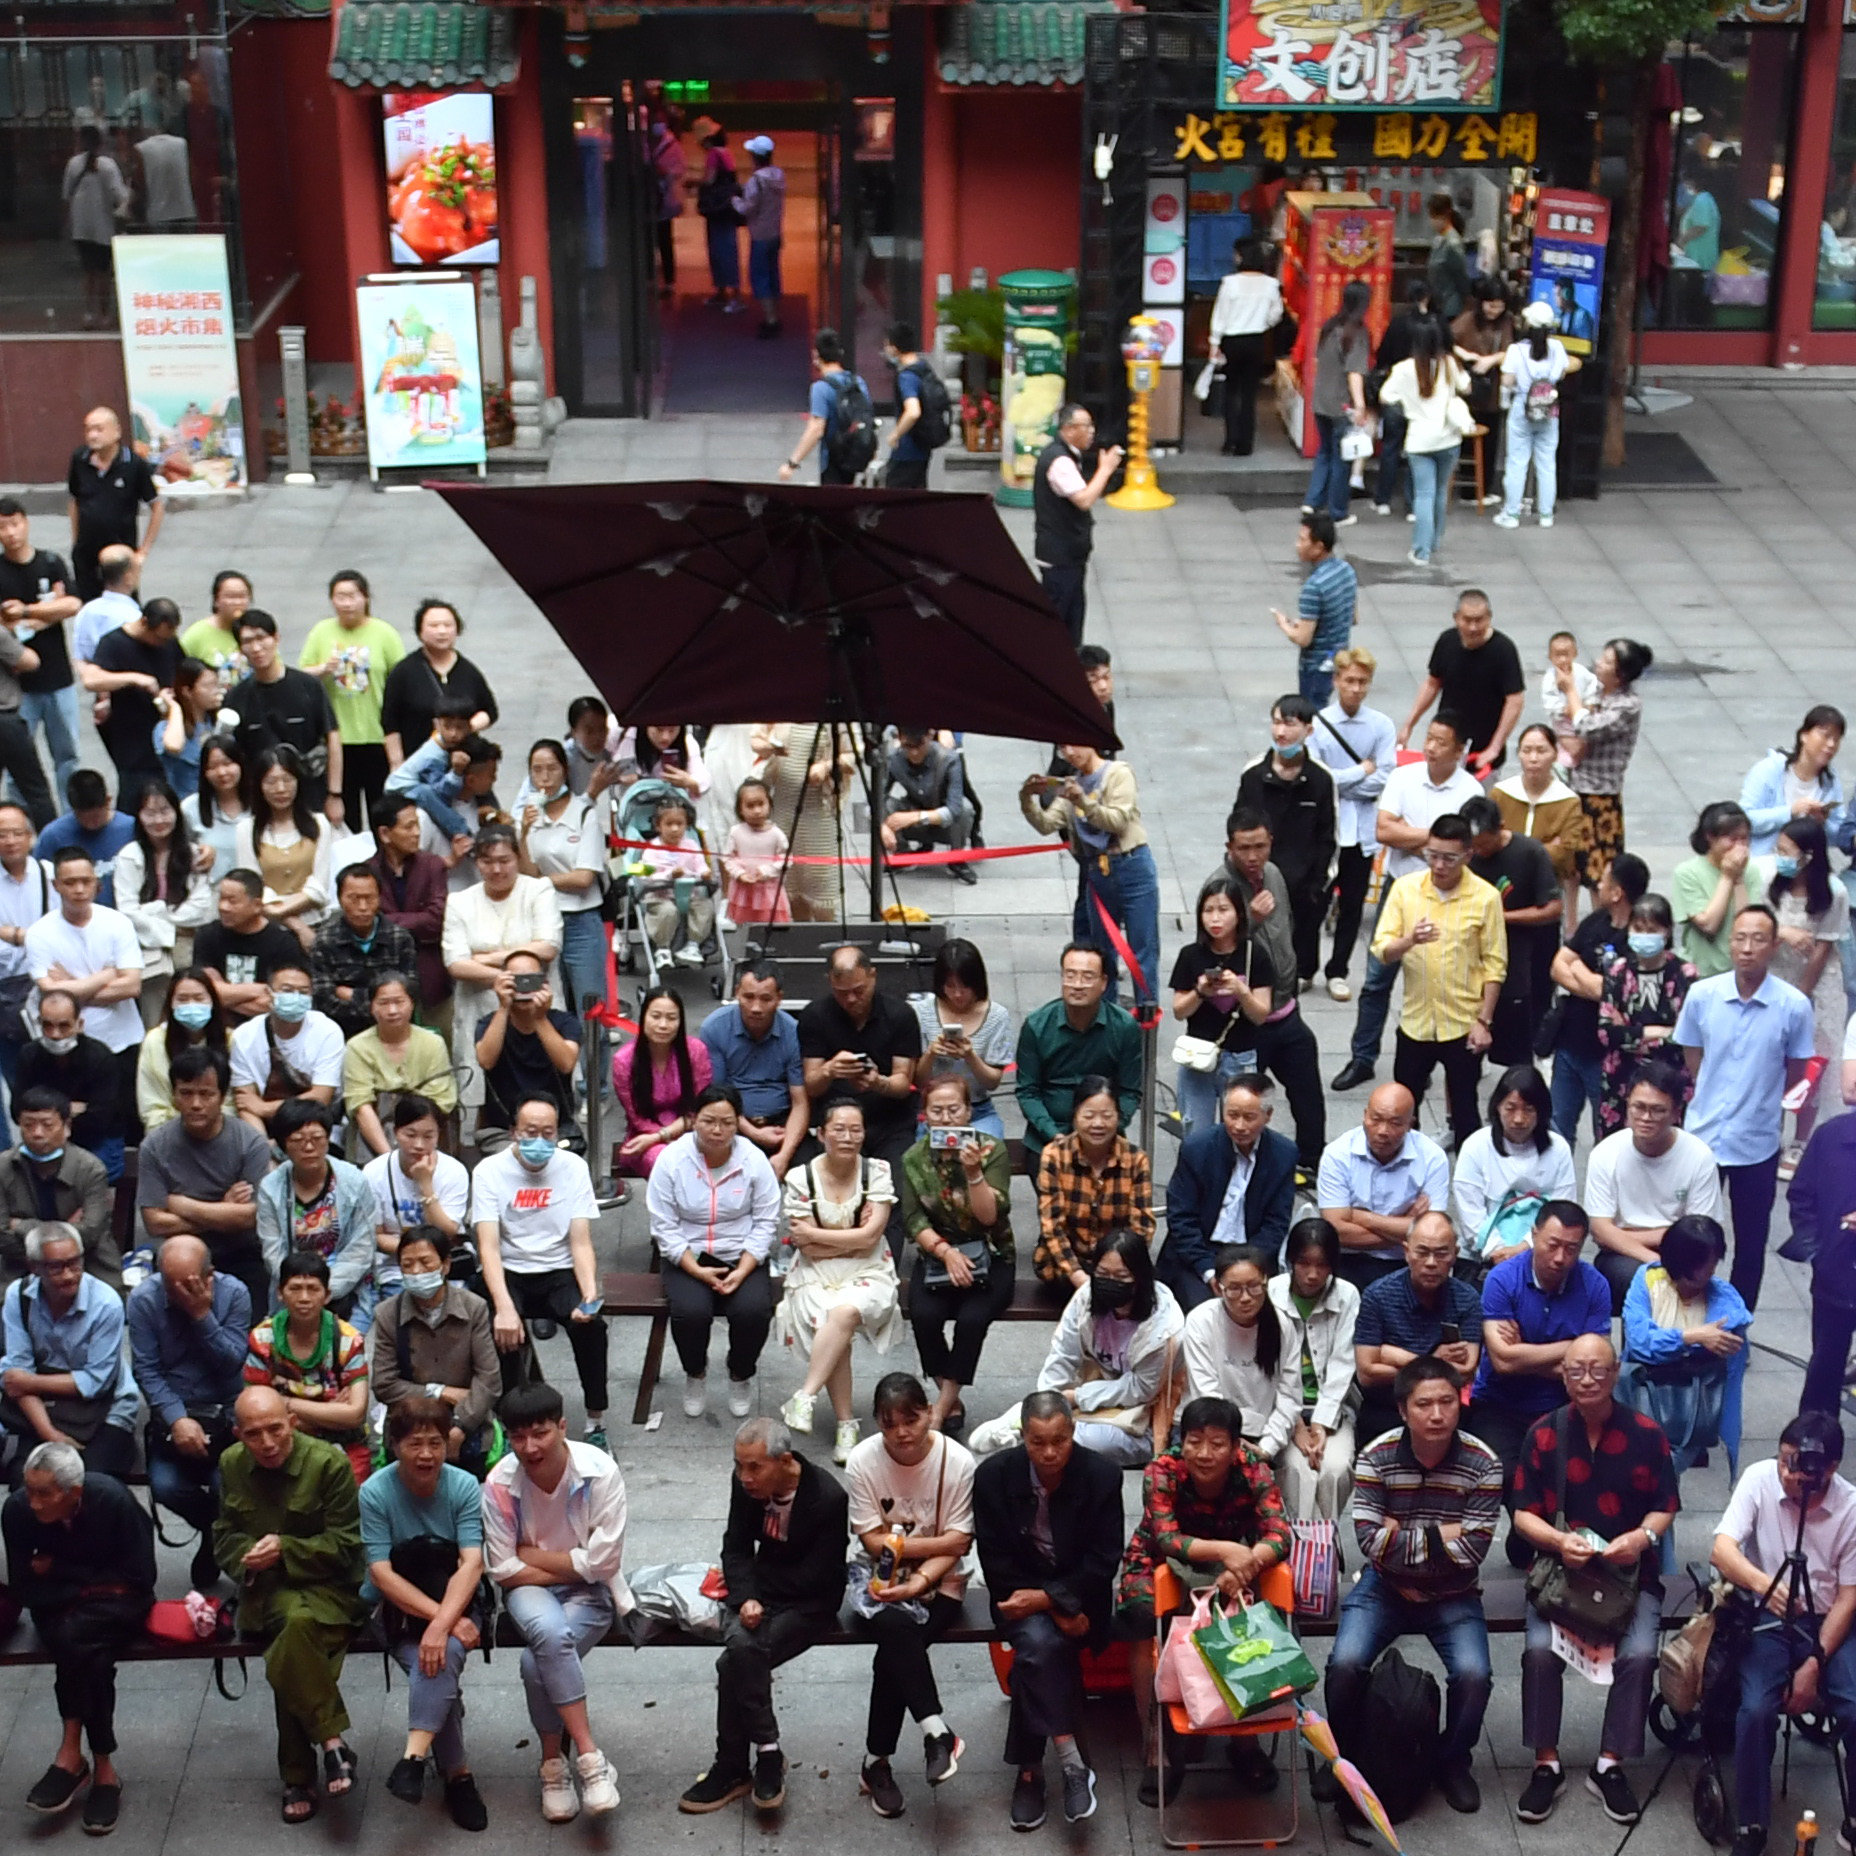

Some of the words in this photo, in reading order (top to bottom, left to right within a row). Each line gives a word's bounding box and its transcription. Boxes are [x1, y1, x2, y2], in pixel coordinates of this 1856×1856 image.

[1251, 26, 1465, 103] 文创店
[513, 1187, 553, 1209] NIKE
